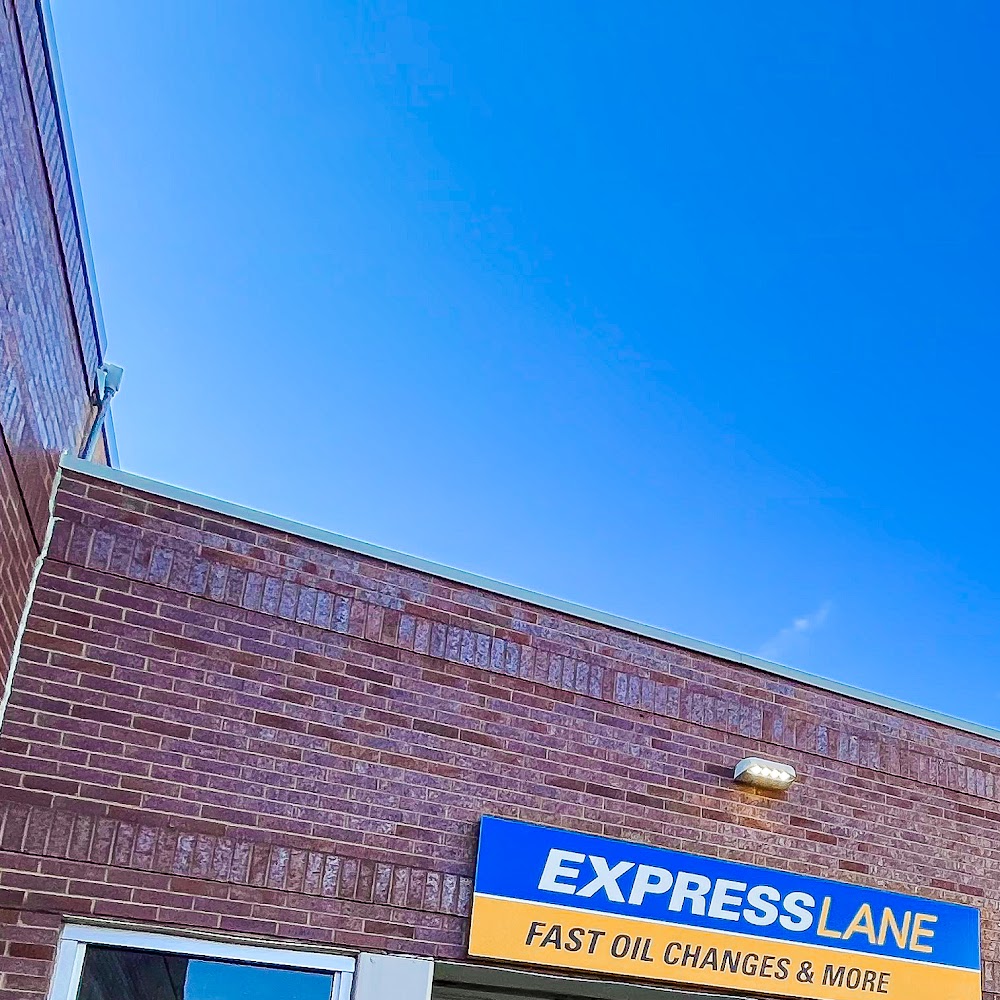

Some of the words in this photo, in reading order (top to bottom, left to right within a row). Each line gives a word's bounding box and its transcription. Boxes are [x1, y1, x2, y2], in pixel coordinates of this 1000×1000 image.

[525, 921, 606, 954] FAST
[610, 933, 654, 963] OIL
[663, 942, 791, 981] CHANGES
[800, 960, 814, 983] &
[821, 965, 892, 995] MORE
